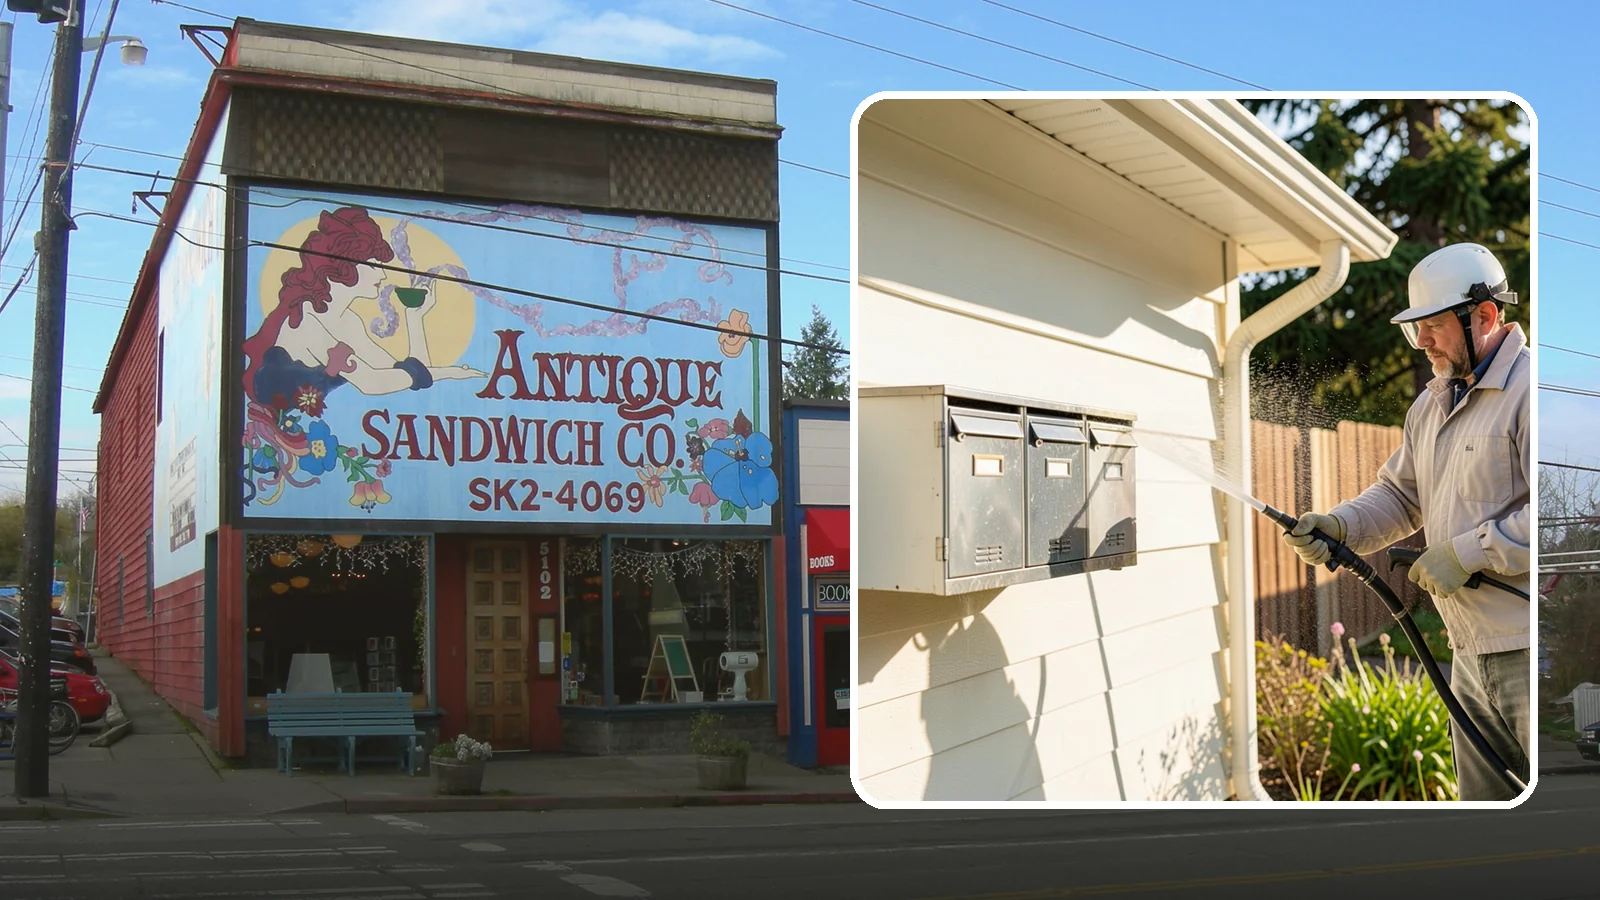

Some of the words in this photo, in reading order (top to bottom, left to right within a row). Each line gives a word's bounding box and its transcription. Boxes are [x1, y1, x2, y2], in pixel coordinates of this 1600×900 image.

[475, 329, 724, 421] ANTIQUE
[361, 408, 605, 468] SANDWICH
[617, 421, 686, 469] CO.
[468, 477, 646, 514] SK2-4069
[539, 541, 552, 600] 5102
[809, 555, 835, 569] BOOKS
